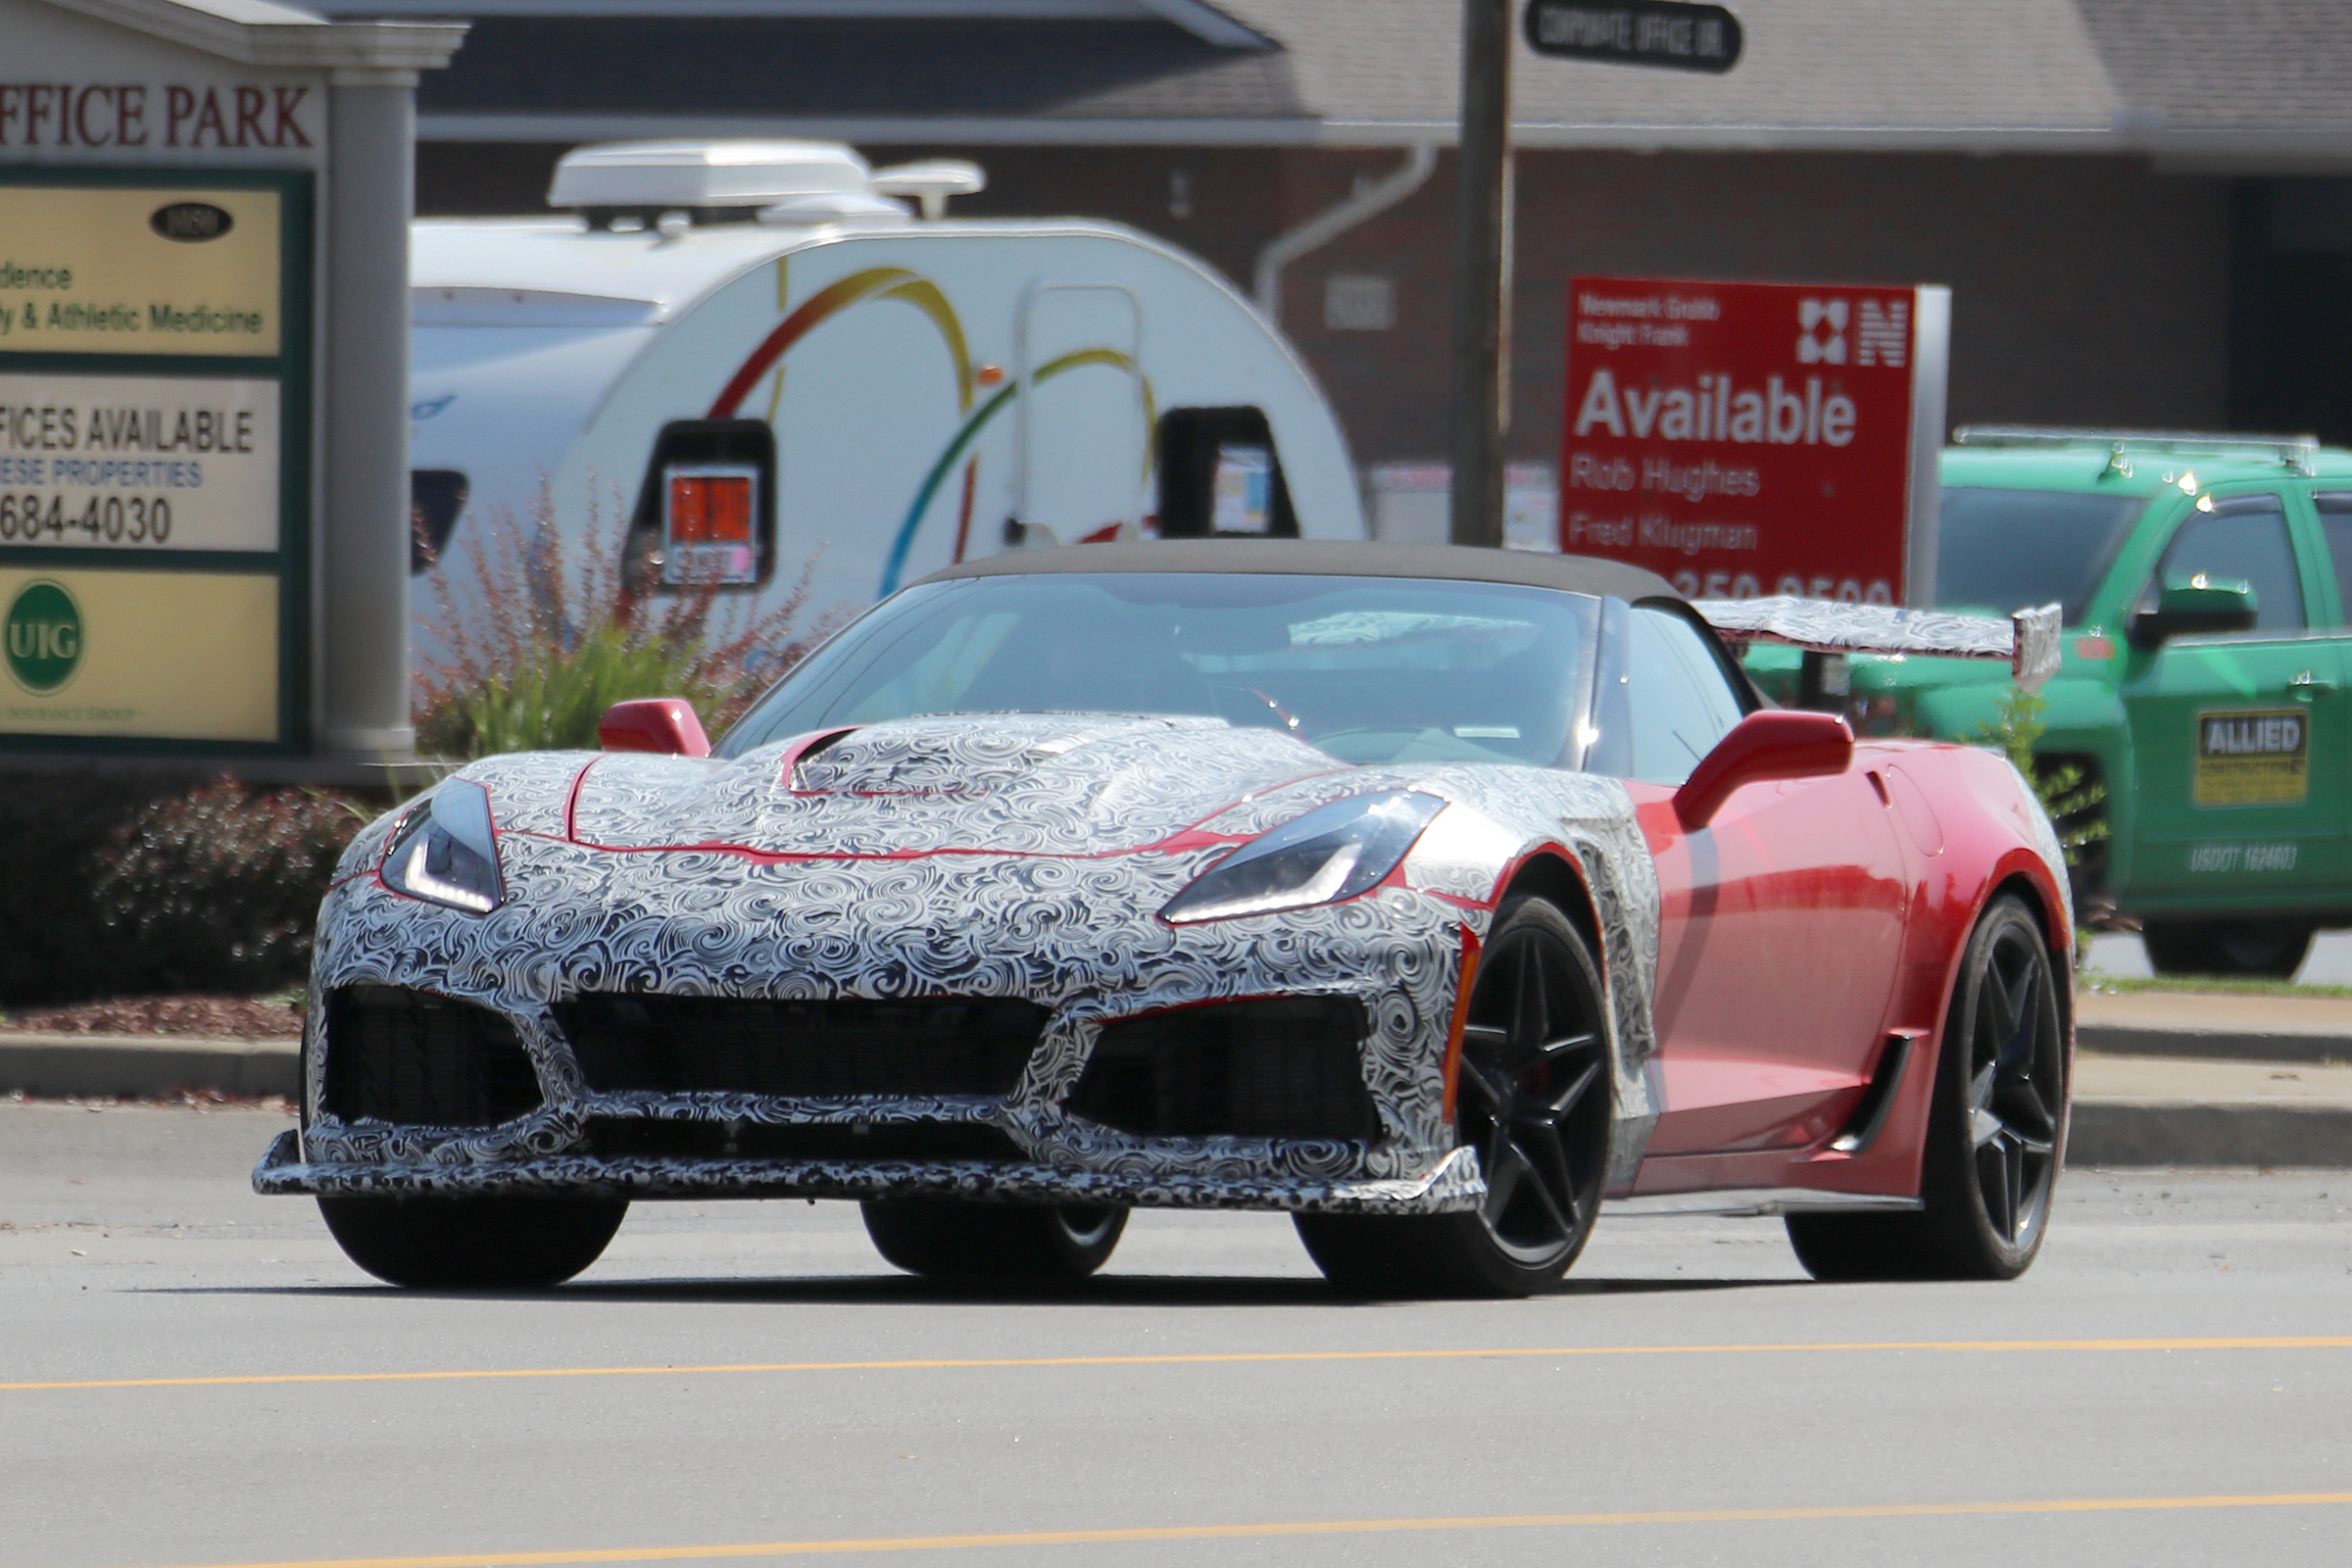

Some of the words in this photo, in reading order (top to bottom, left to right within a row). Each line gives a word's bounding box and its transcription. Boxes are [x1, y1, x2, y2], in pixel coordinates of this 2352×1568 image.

[164, 84, 313, 147] PARK
[22, 302, 38, 330] &
[48, 302, 140, 331] Athletic
[149, 304, 264, 334] Medicine
[1574, 368, 1856, 447] Available
[85, 408, 254, 454] AVAILABLE
[53, 460, 203, 488] PROPERTIES
[1571, 454, 1635, 491] Rob
[1642, 457, 1760, 502] Hughes
[0, 494, 172, 543] 684-4030
[1570, 514, 1632, 547] Fred
[1640, 515, 1757, 556] Klugman
[10, 623, 77, 659] UIG
[2208, 717, 2300, 754] ALLIED
[2190, 846, 2240, 872] USDOT
